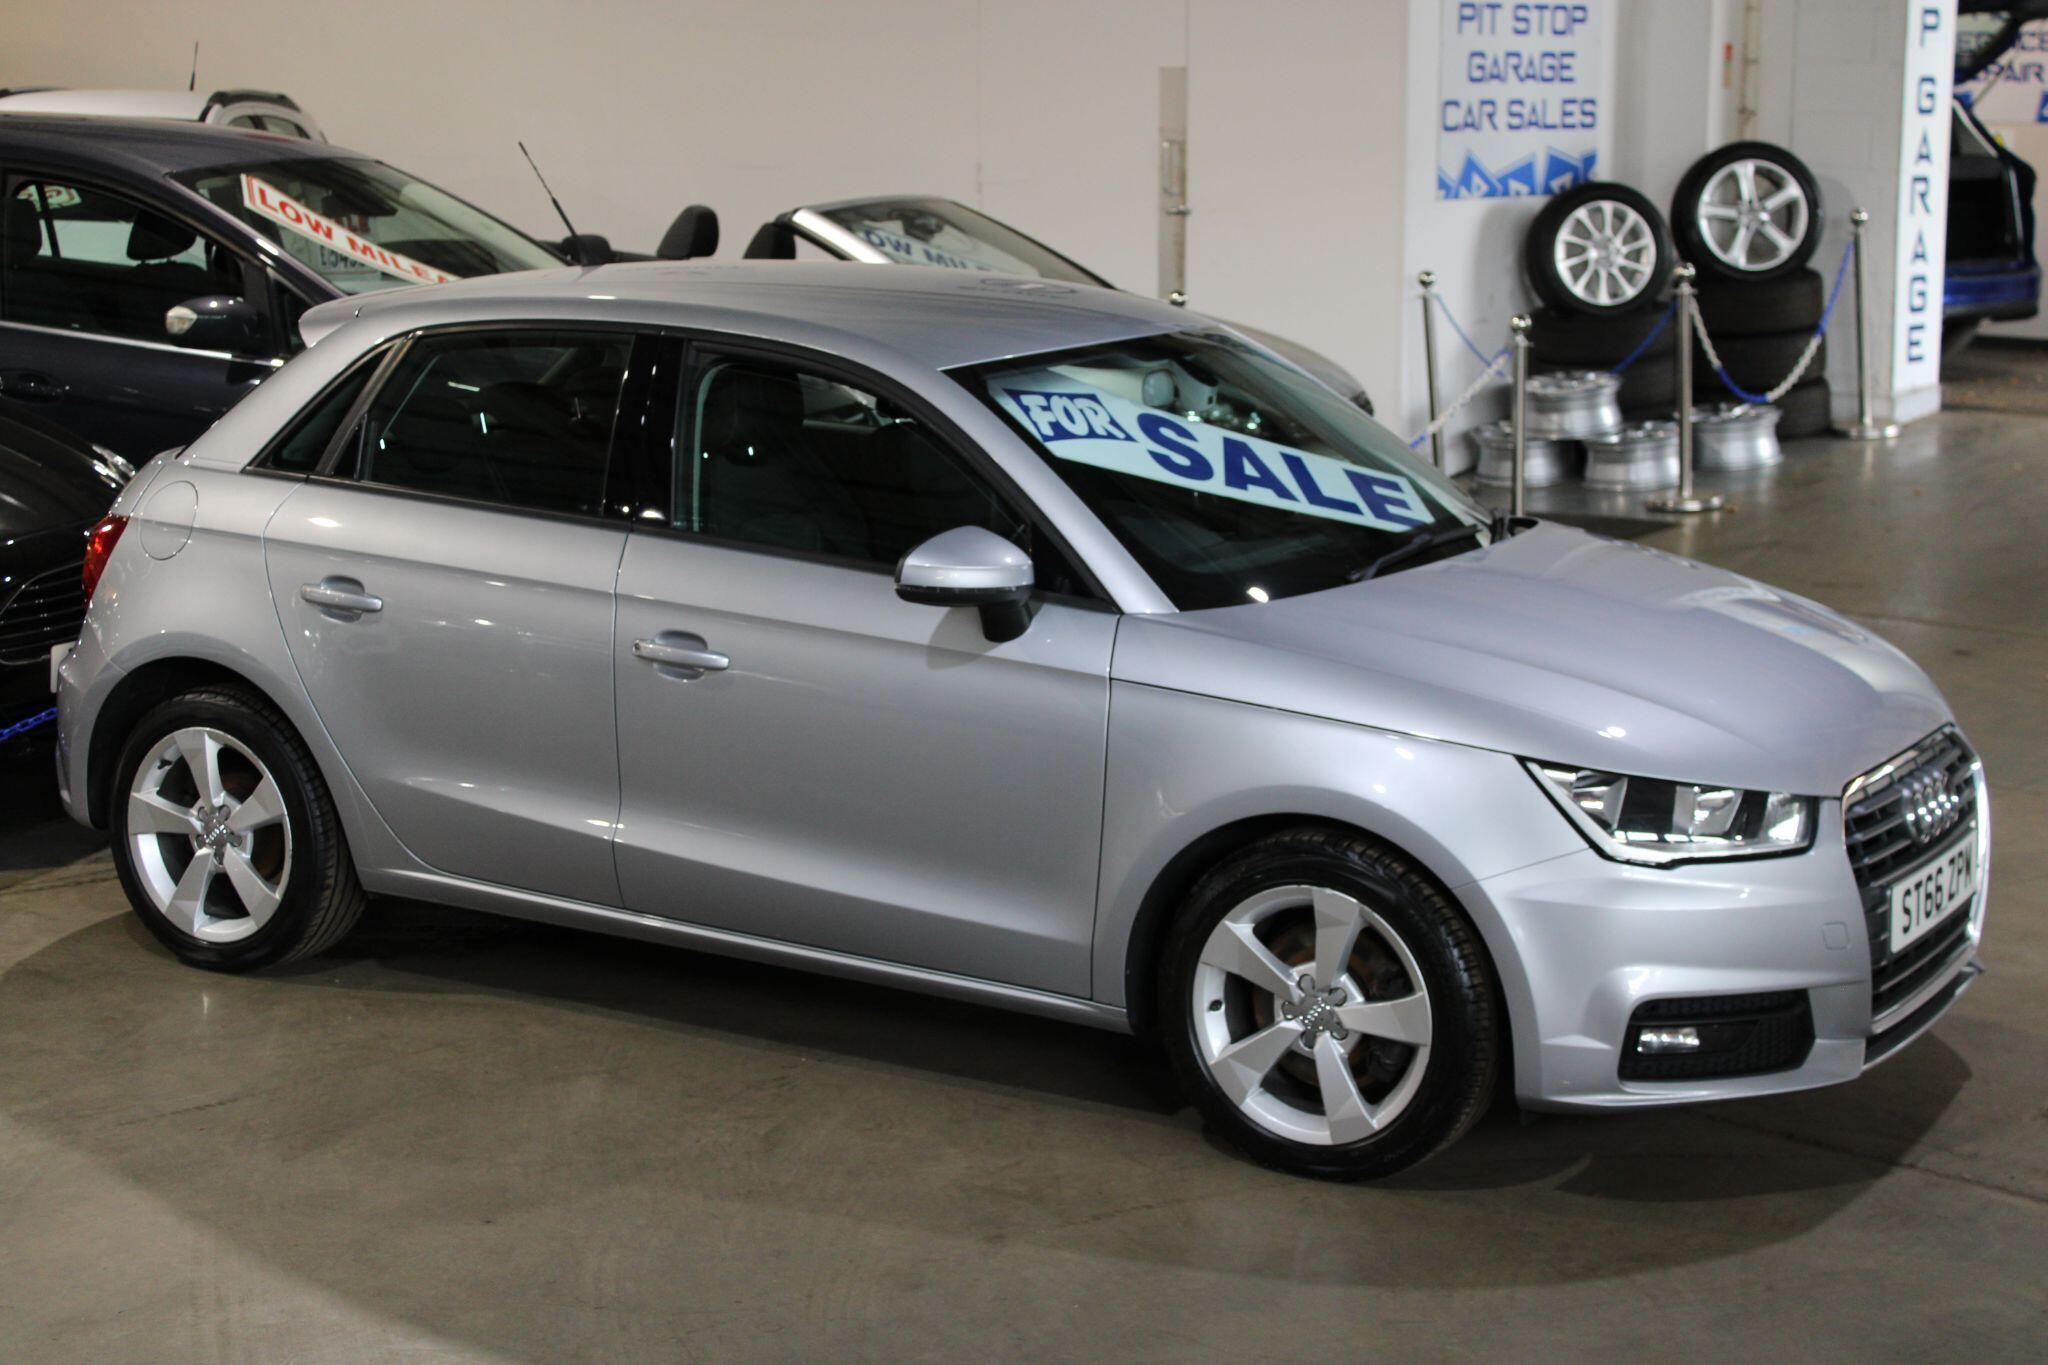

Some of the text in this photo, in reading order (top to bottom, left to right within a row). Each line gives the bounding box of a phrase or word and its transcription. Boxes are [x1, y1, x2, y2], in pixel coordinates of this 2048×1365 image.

[1457, 3, 1588, 35] PIT STOP
[1468, 52, 1576, 82] GARAGE
[1442, 98, 1597, 132] CAR SALES
[258, 187, 333, 241] LOW
[1907, 76, 1937, 363] GARAGE
[864, 228, 912, 256] OW
[1019, 393, 1429, 530] FOR SALE
[1902, 866, 1943, 935] ST66
